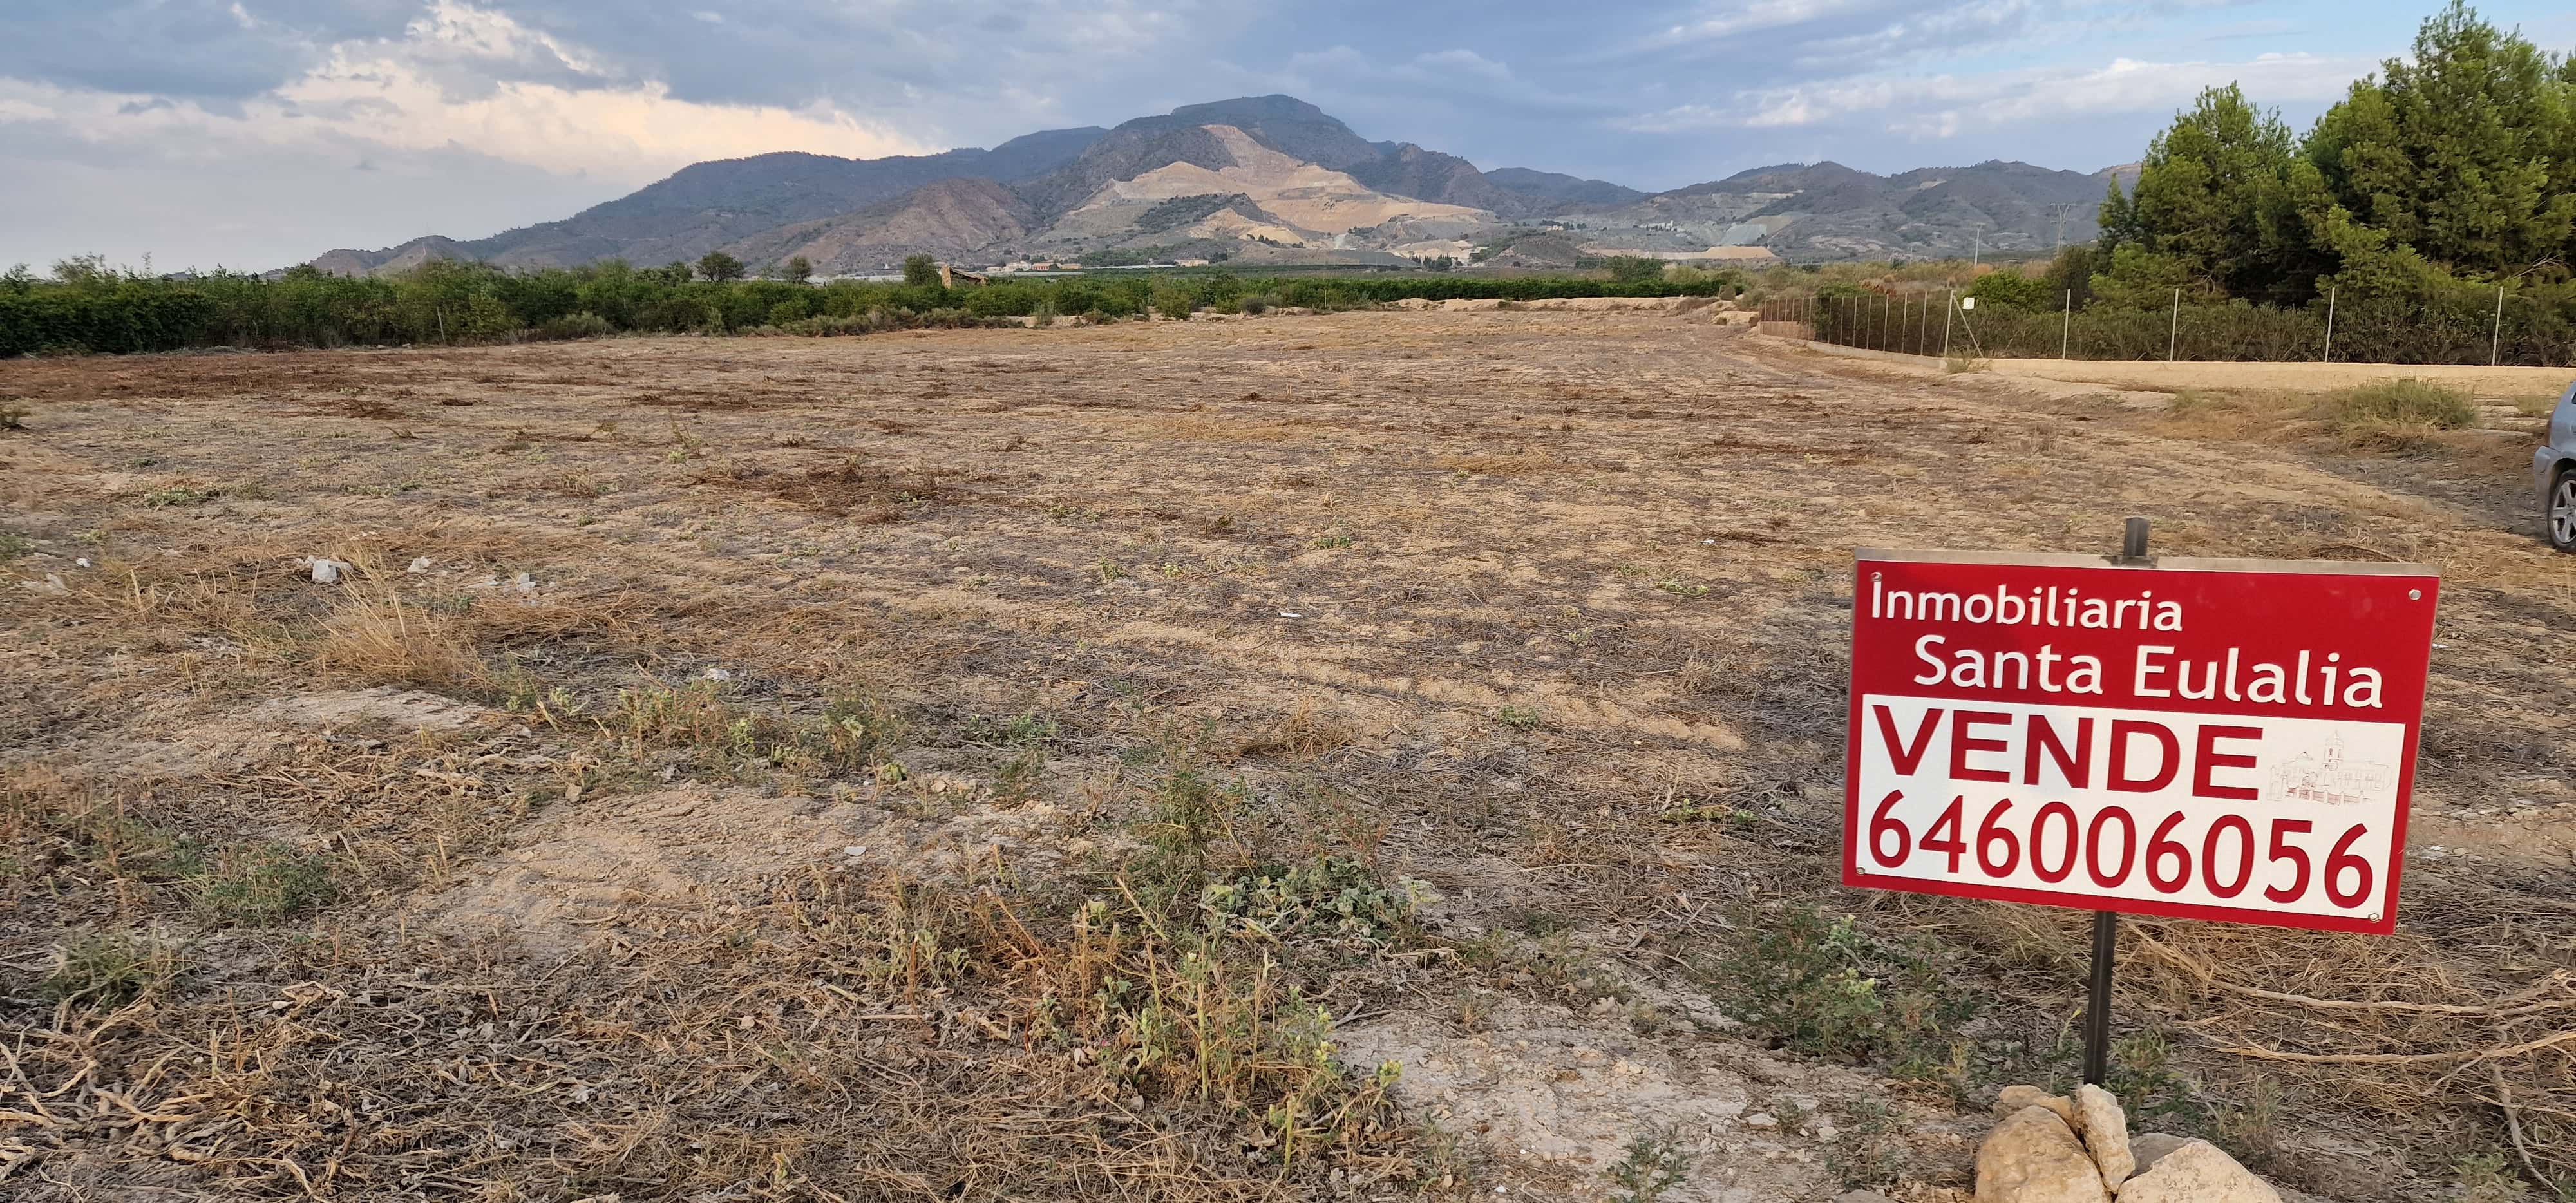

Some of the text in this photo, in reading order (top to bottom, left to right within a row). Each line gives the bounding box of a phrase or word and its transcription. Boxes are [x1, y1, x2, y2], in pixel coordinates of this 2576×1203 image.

[1871, 579, 2183, 632] Inmobiliaria
[1913, 634, 2383, 708] Santa Eulalia
[1874, 705, 2264, 800] VENDE
[1869, 790, 2374, 910] 646006056
